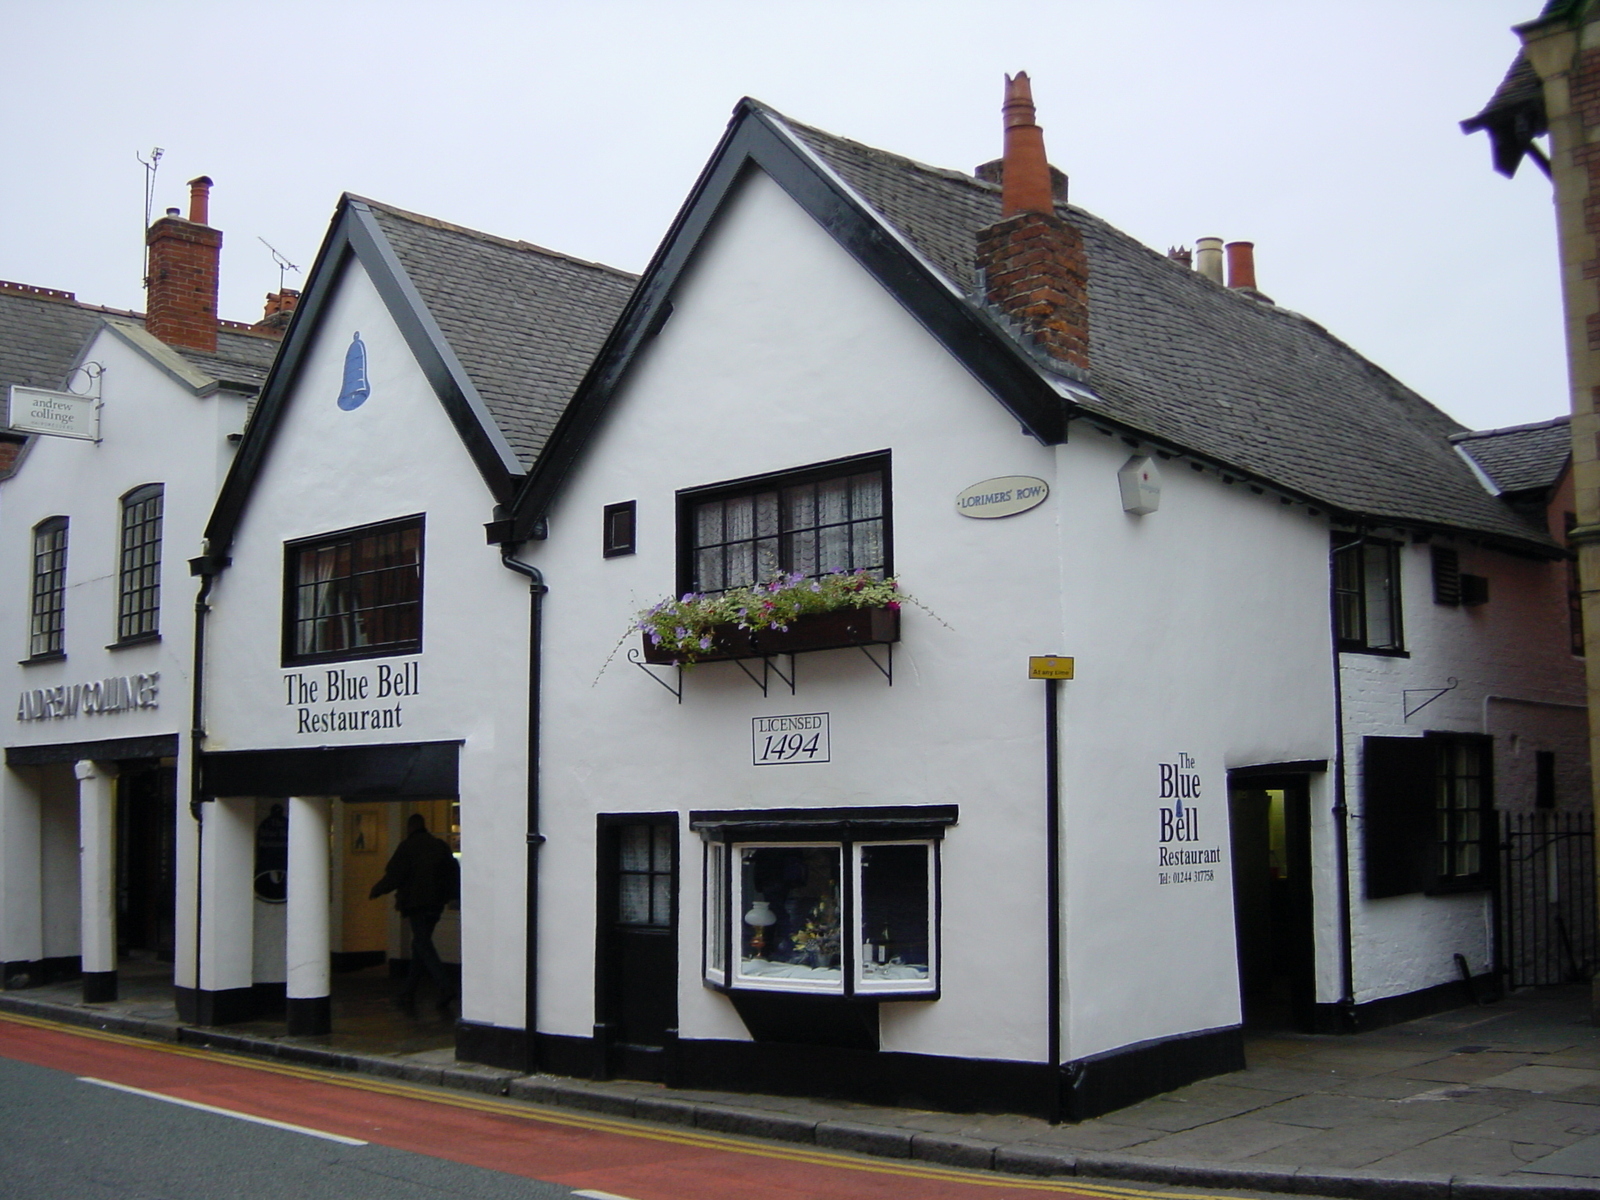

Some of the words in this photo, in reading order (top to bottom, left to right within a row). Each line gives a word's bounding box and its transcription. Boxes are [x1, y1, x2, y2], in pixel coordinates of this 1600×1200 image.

[32, 398, 73, 411] andrew
[30, 408, 74, 425] collinge
[1016, 486, 1042, 500] ROW
[283, 673, 318, 705] The
[325, 669, 369, 702] Blue
[376, 661, 420, 698] Bell
[17, 684, 82, 722] ANDREW
[82, 672, 161, 716] COLLINGE
[297, 701, 403, 734] Restaurant
[759, 716, 822, 732] LICENSED
[759, 732, 820, 760] 1494
[1178, 752, 1195, 769] The
[1158, 763, 1201, 799] Blue
[1159, 807, 1199, 842] Bell
[1158, 845, 1221, 867] Restaurant
[1158, 872, 1171, 885] Tel:
[1172, 871, 1192, 884] 01244
[1193, 869, 1215, 882] 317758
